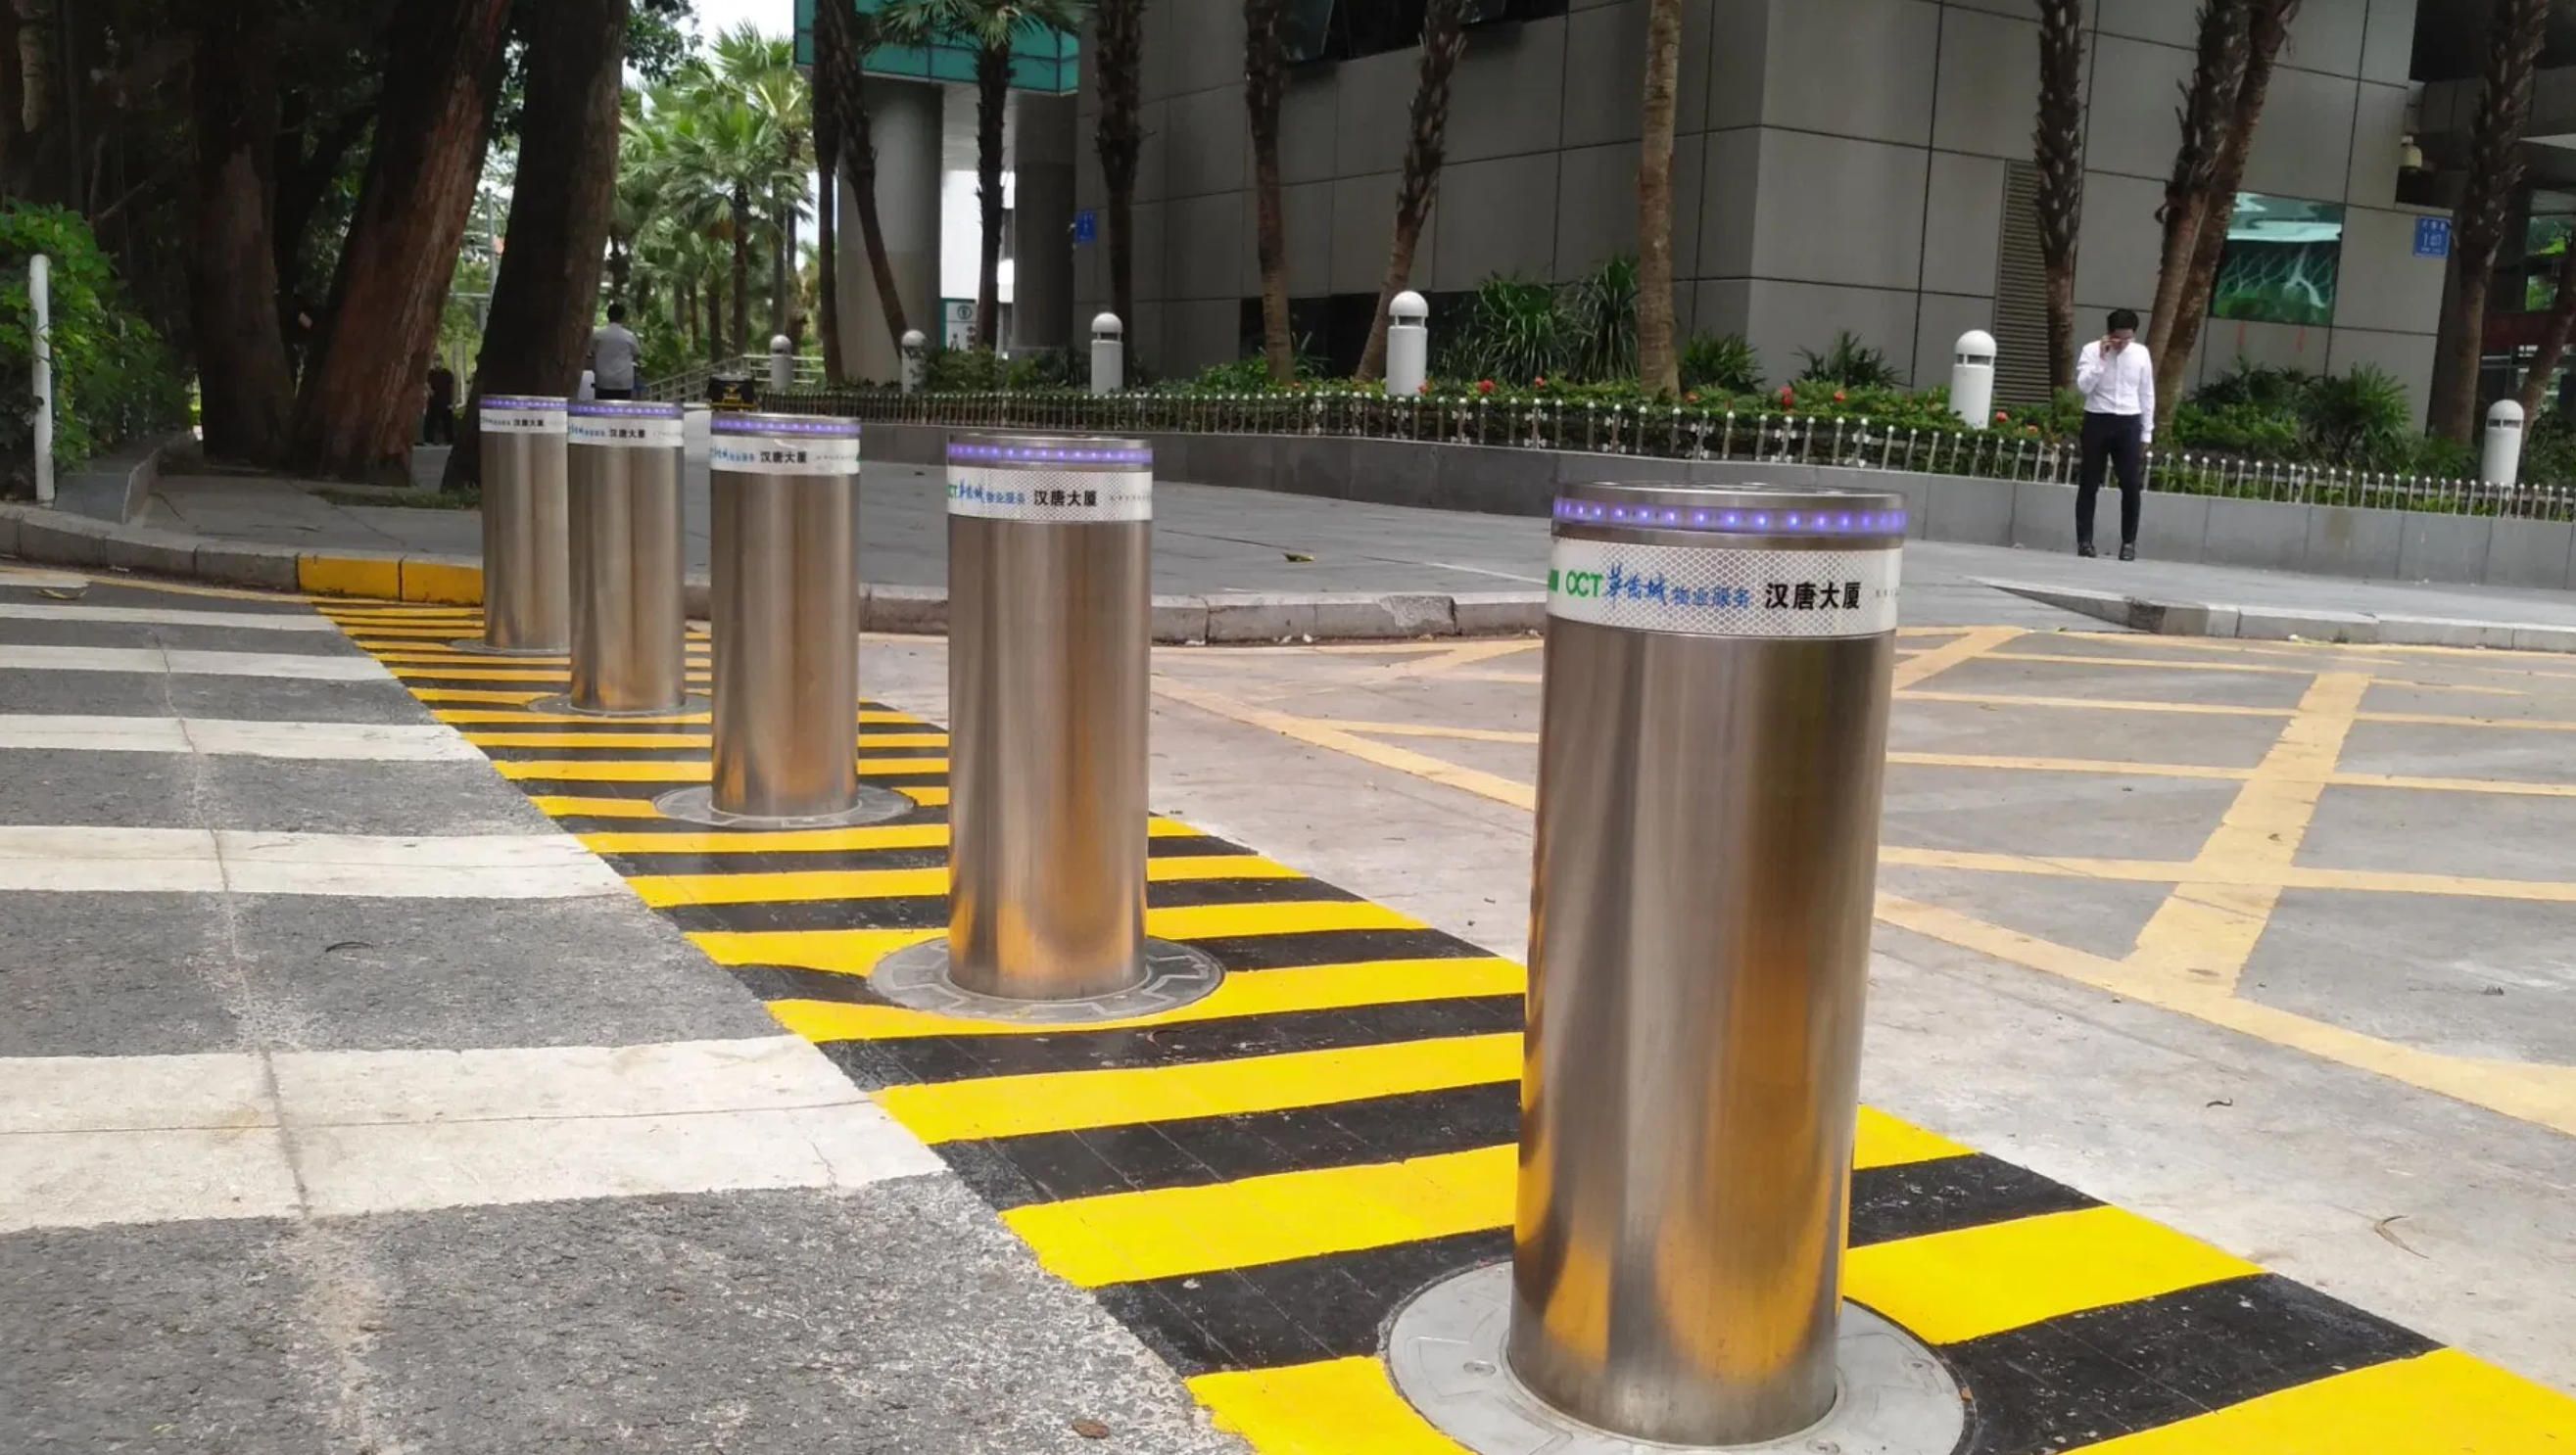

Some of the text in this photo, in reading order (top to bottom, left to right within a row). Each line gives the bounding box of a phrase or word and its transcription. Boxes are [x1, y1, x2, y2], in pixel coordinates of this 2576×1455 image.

[1033, 490, 1097, 507] 汉唐大厦
[1566, 570, 1603, 598] OCT
[1764, 582, 1861, 610] 汉唐大厦
